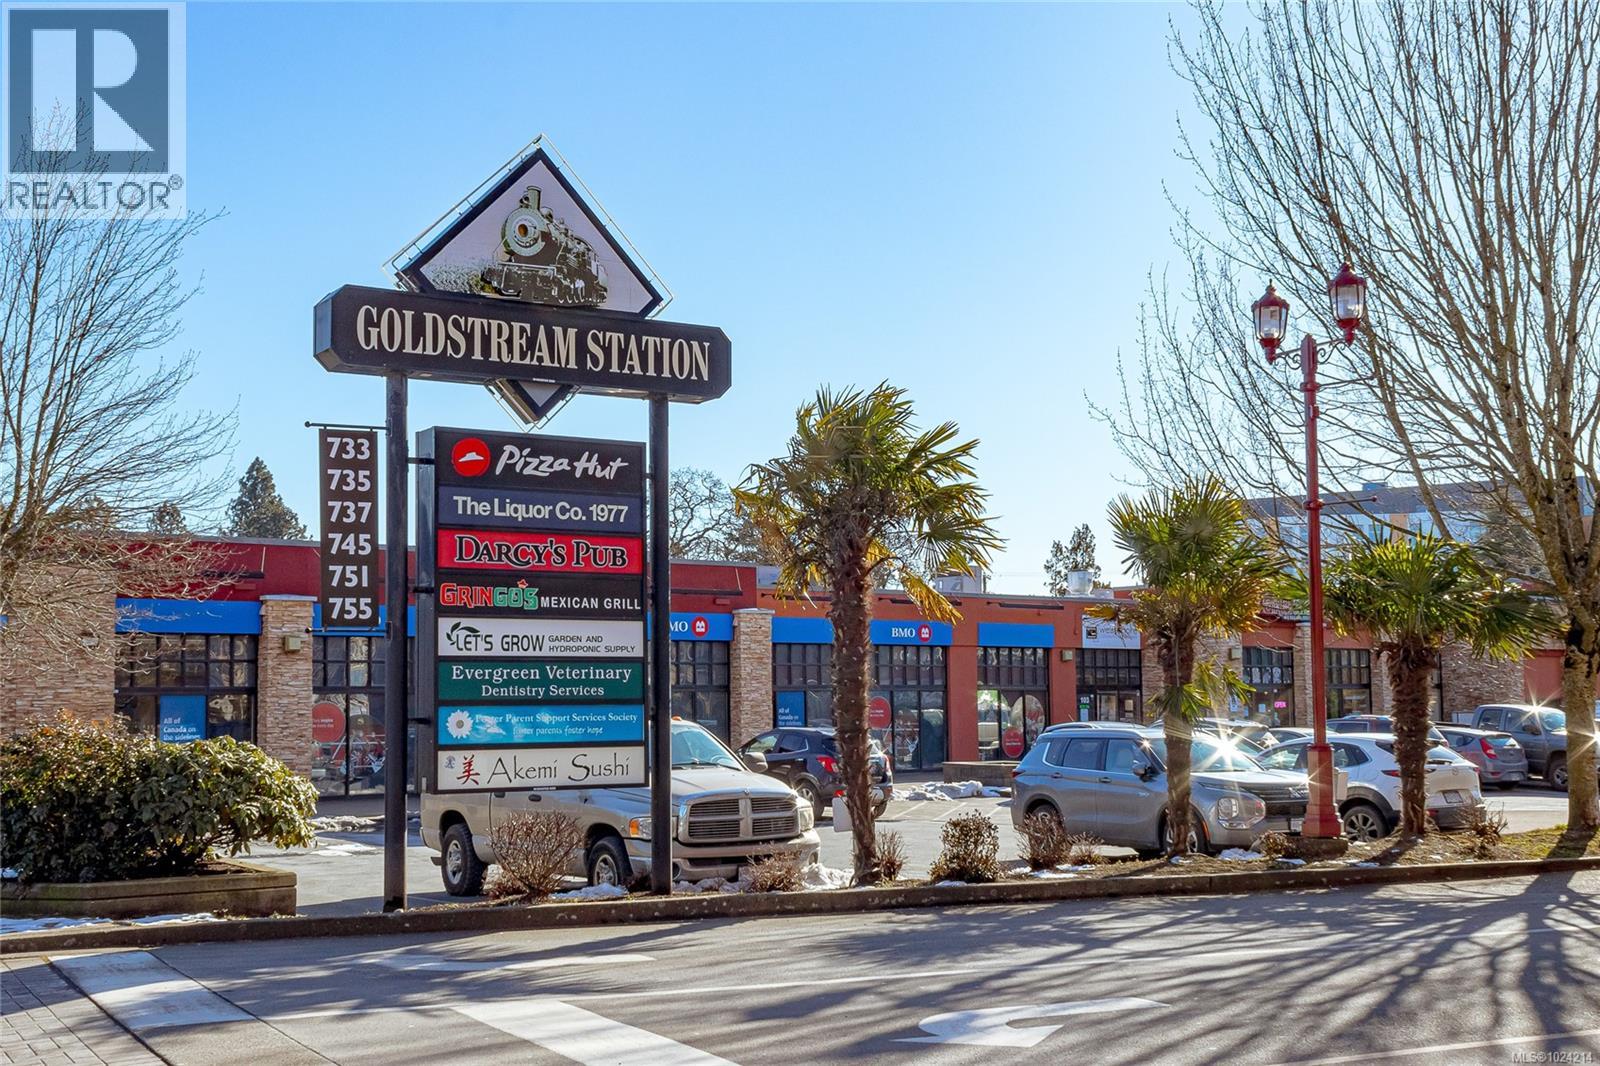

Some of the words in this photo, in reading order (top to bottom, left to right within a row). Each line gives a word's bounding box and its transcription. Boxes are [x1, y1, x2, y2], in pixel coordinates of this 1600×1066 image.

[356, 304, 578, 370] GOLDSTREAM
[586, 328, 711, 382] STATION
[326, 437, 371, 460] 733
[495, 444, 571, 477] Pizza
[573, 451, 629, 480] Hut
[327, 468, 372, 492] 735
[327, 501, 372, 523] 737
[453, 495, 491, 516] The
[494, 498, 553, 522] Liquor
[555, 501, 587, 521] Co.
[589, 503, 629, 523] 1977
[328, 533, 372, 555] 745
[455, 534, 566, 569] DARCY'S
[572, 540, 628, 568] PUB
[328, 565, 369, 587] 751
[328, 597, 373, 620] 755
[540, 596, 599, 609] MEXICAN
[603, 597, 641, 610] GRILL
[669, 620, 689, 632] MO
[891, 627, 916, 638] BMO
[456, 634, 494, 651] LET'S
[501, 634, 546, 652] GROW
[548, 635, 582, 643] GARDEN
[586, 635, 604, 643] AND
[548, 645, 602, 653] HYDROPONIC
[604, 645, 636, 653] SUPPLY
[452, 665, 540, 684] Evergreen
[546, 665, 632, 683] Veterinary
[482, 684, 545, 698] Dentistry
[549, 684, 605, 696] Services
[505, 713, 534, 723] Parent
[571, 712, 606, 722] Services
[608, 712, 638, 723] Society
[535, 727, 563, 737] parents
[456, 754, 481, 785] 美
[487, 755, 558, 784] Akemi
[568, 752, 630, 782] Sushi
